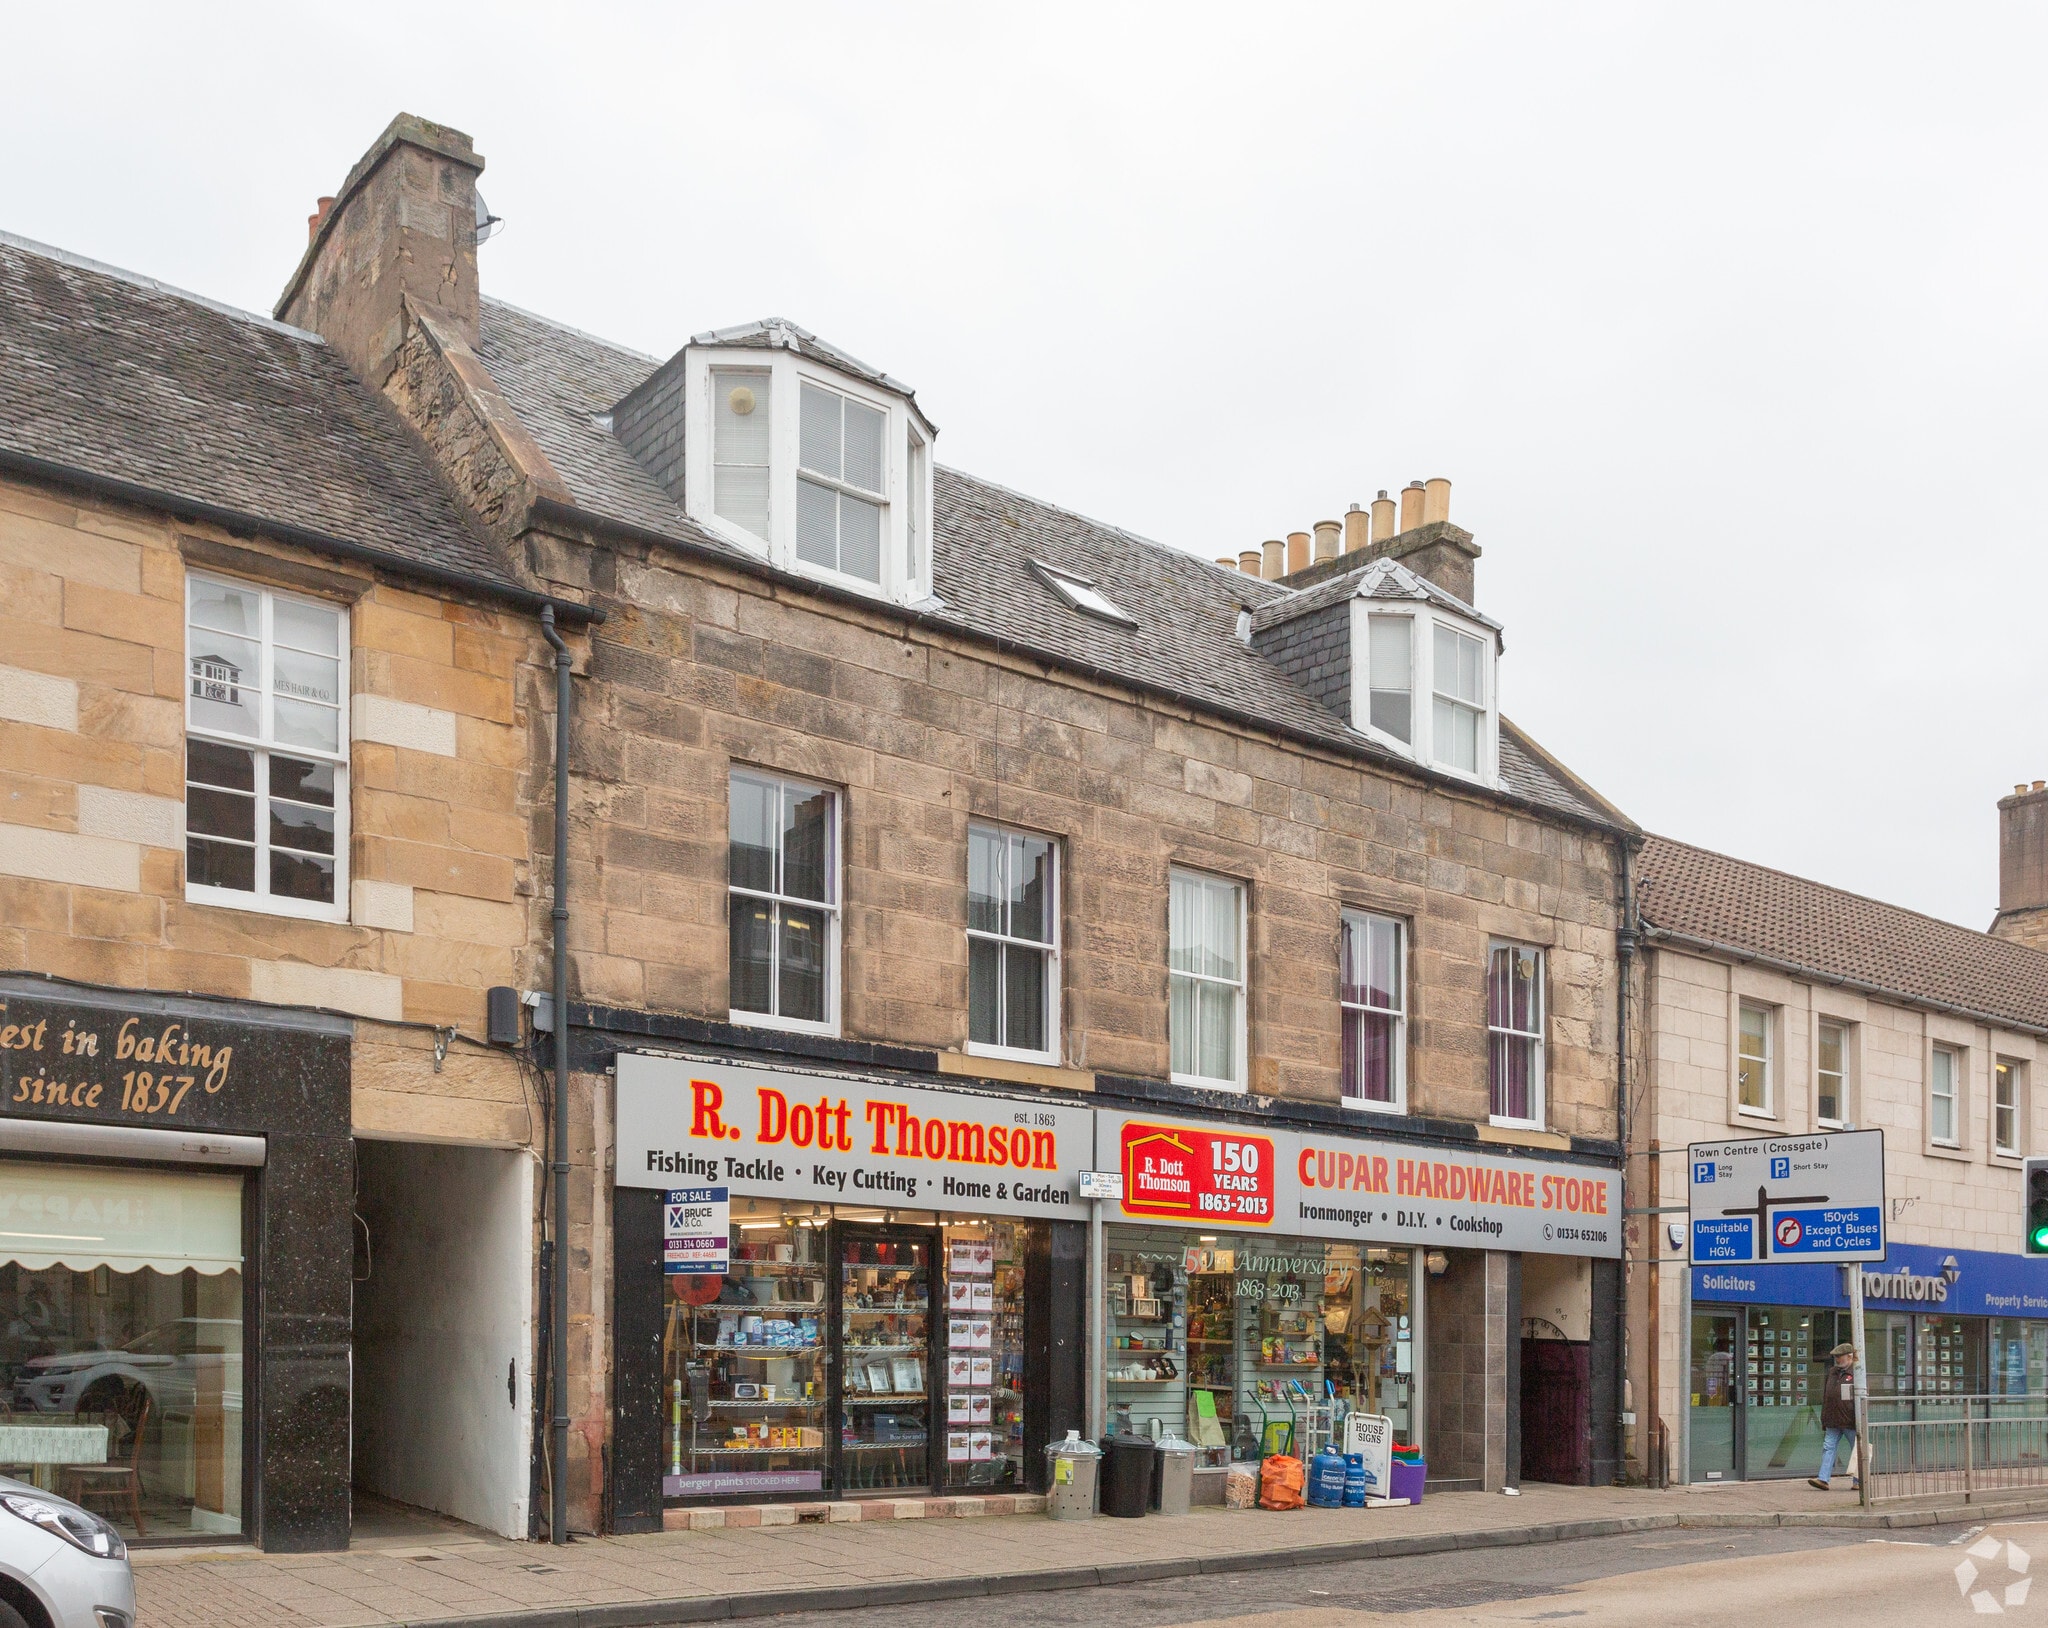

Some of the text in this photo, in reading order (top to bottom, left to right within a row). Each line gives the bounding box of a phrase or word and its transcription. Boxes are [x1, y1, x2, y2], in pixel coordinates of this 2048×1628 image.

[291, 683, 310, 697] HAIR
[311, 687, 318, 698] &
[319, 689, 330, 700] CO
[62, 1019, 99, 1057] in
[116, 1017, 233, 1094] baking
[13, 1067, 195, 1115] since 1857
[689, 1078, 1059, 1172] R. Dott Thomson
[1014, 1111, 1056, 1127] est. 1863
[1211, 1141, 1259, 1174] 150
[1694, 1148, 1720, 1158] Town
[1724, 1145, 1759, 1156] Centre
[1144, 1156, 1184, 1176] R. Dott
[1718, 1164, 1733, 1172] Long
[1793, 1163, 1811, 1171] Short
[1813, 1162, 1829, 1170] Stay
[647, 1150, 1070, 1205] Fishing Tackle Key Cutting Home & Garden
[1213, 1173, 1258, 1192] YEARS
[1297, 1147, 1609, 1216] CUPAR HARDWARE STORE
[1718, 1171, 1733, 1179] Stay
[1138, 1173, 1191, 1193] Thomson
[671, 1190, 712, 1203] FOR SALE
[1198, 1193, 1268, 1215] 1863-2013
[684, 1208, 713, 1218] BRUCE
[1299, 1202, 1503, 1239] Ironmonger D.I.Y. Cookshop
[1823, 1211, 1859, 1223] 150yds
[684, 1217, 703, 1228] & Co.
[1696, 1223, 1749, 1234] Unsuitable
[1805, 1223, 1878, 1236] Except Buses
[1557, 1227, 1608, 1243] 01334 652106
[1716, 1235, 1730, 1245] for
[1812, 1236, 1872, 1249] and Cycles
[668, 1239, 715, 1249] 0131 314 0660
[1709, 1247, 1736, 1257] HGVs
[1233, 1250, 1349, 1285] Anniversary
[1702, 1274, 1756, 1292] Solicitors
[1985, 1293, 2021, 1309] Property
[1355, 1422, 1384, 1435] HOUSE
[1358, 1433, 1381, 1444] SIGNS
[679, 1476, 800, 1490] berger paints STOCKED HERE
